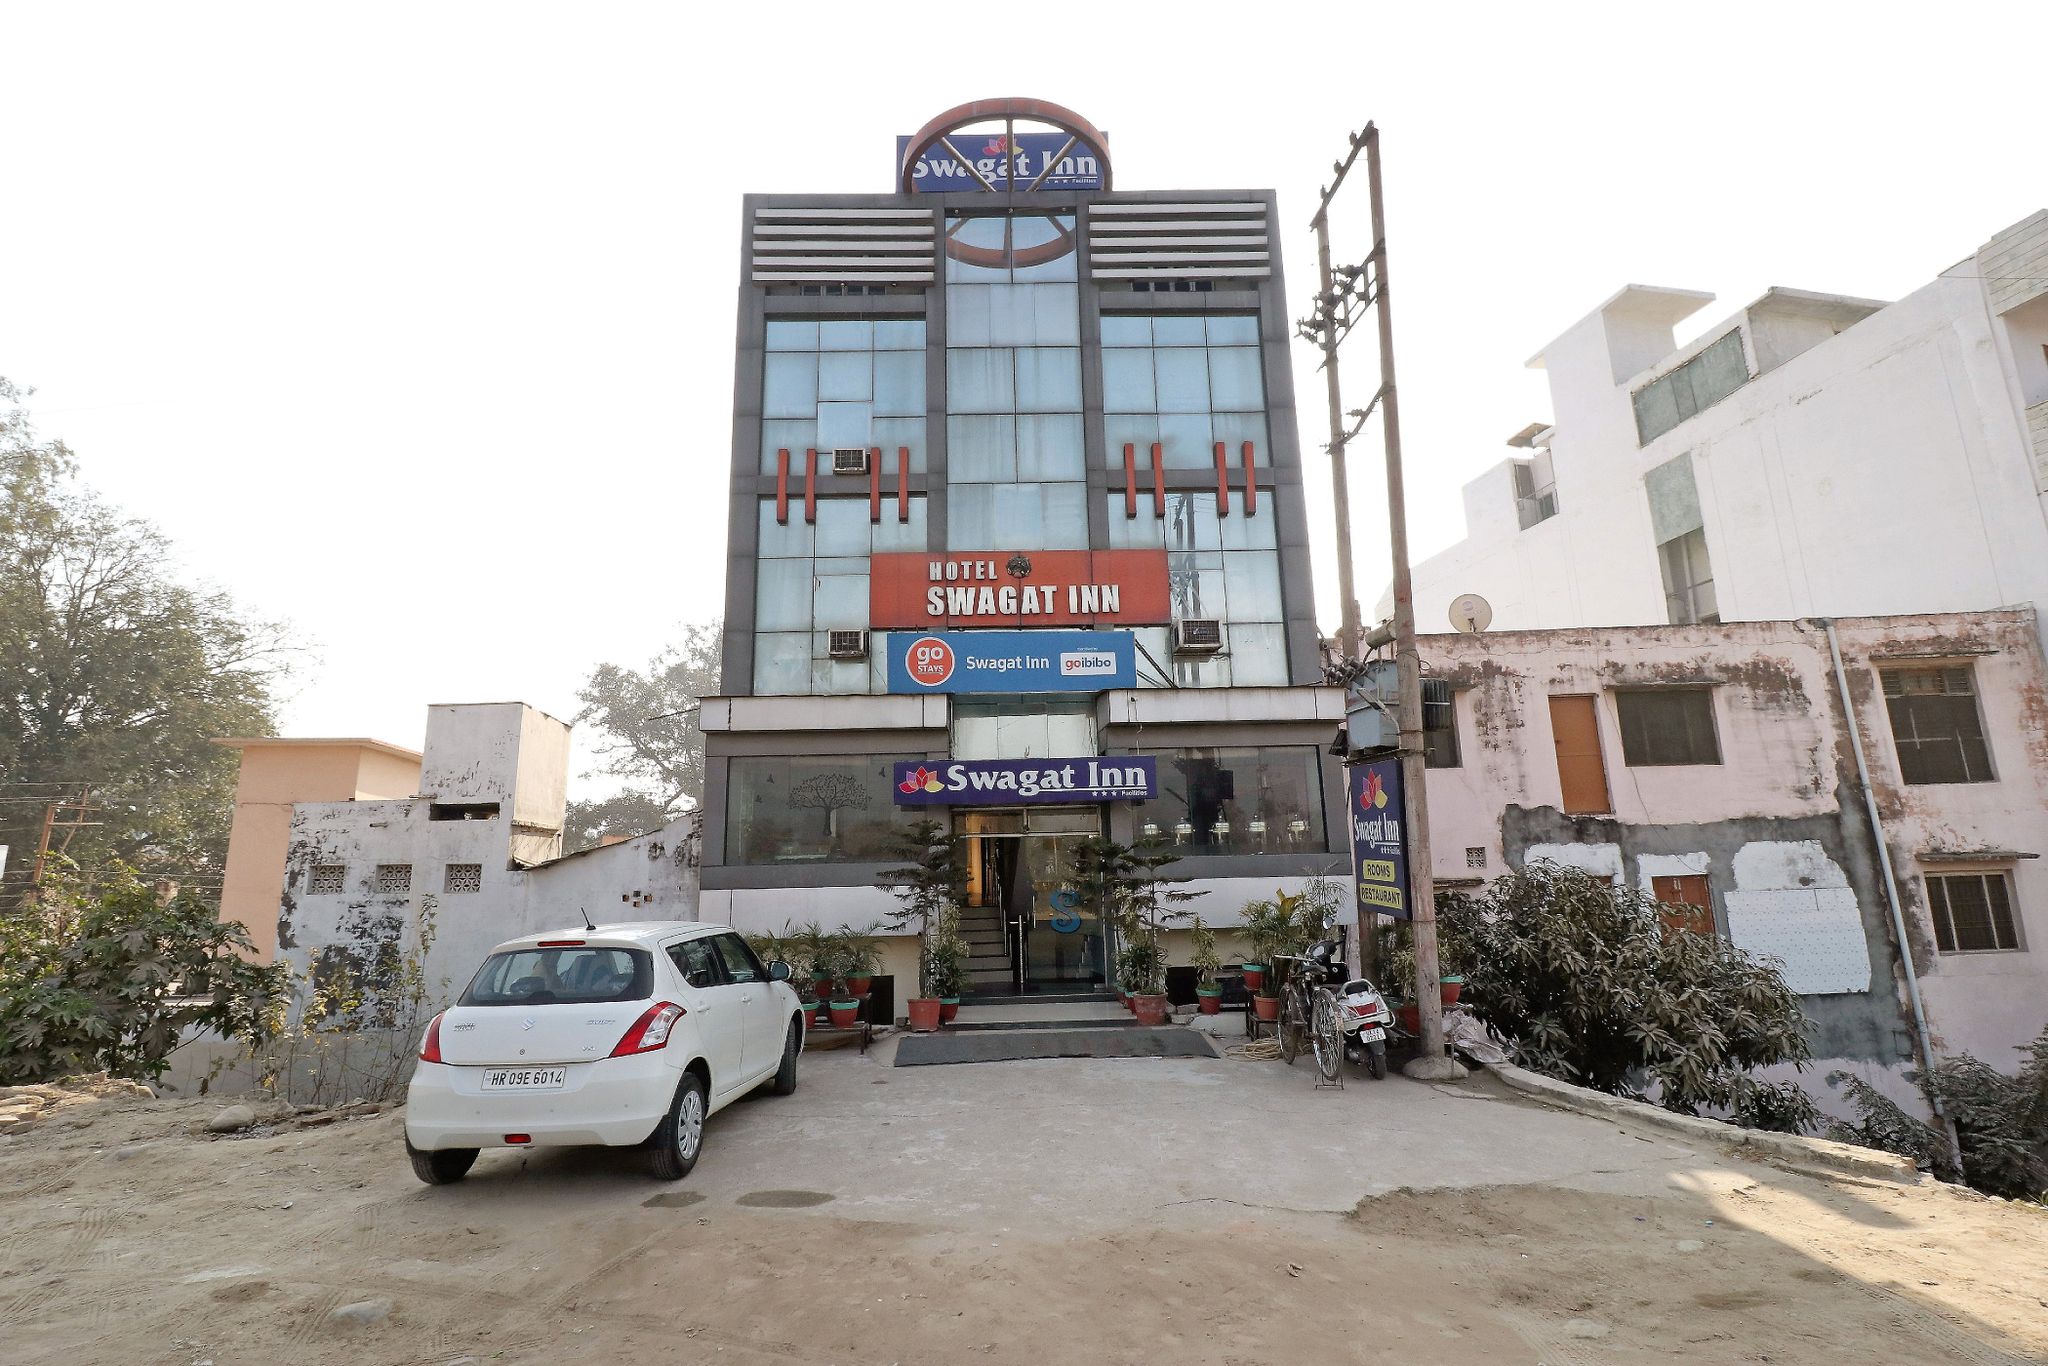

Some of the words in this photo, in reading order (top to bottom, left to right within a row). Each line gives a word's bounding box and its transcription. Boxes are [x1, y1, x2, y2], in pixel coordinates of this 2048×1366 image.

[929, 560, 998, 581] HOTEL
[927, 585, 1058, 616] SWAGAT
[1068, 584, 1120, 614] INN
[917, 647, 944, 665] go
[966, 656, 1022, 673] Swagat
[1026, 655, 1050, 669] Inn
[1065, 657, 1111, 671] goibibo
[917, 665, 944, 673] STAYS
[947, 764, 1076, 796] Swagat
[1087, 761, 1147, 788] Inn
[1354, 814, 1383, 849] Swagat
[1383, 812, 1400, 841] Inn
[1367, 863, 1391, 878] ROOMS
[1361, 887, 1401, 905] RESTAURANT
[491, 1072, 507, 1086] HR
[508, 1071, 532, 1085] 09E
[533, 1070, 563, 1085] 6014
